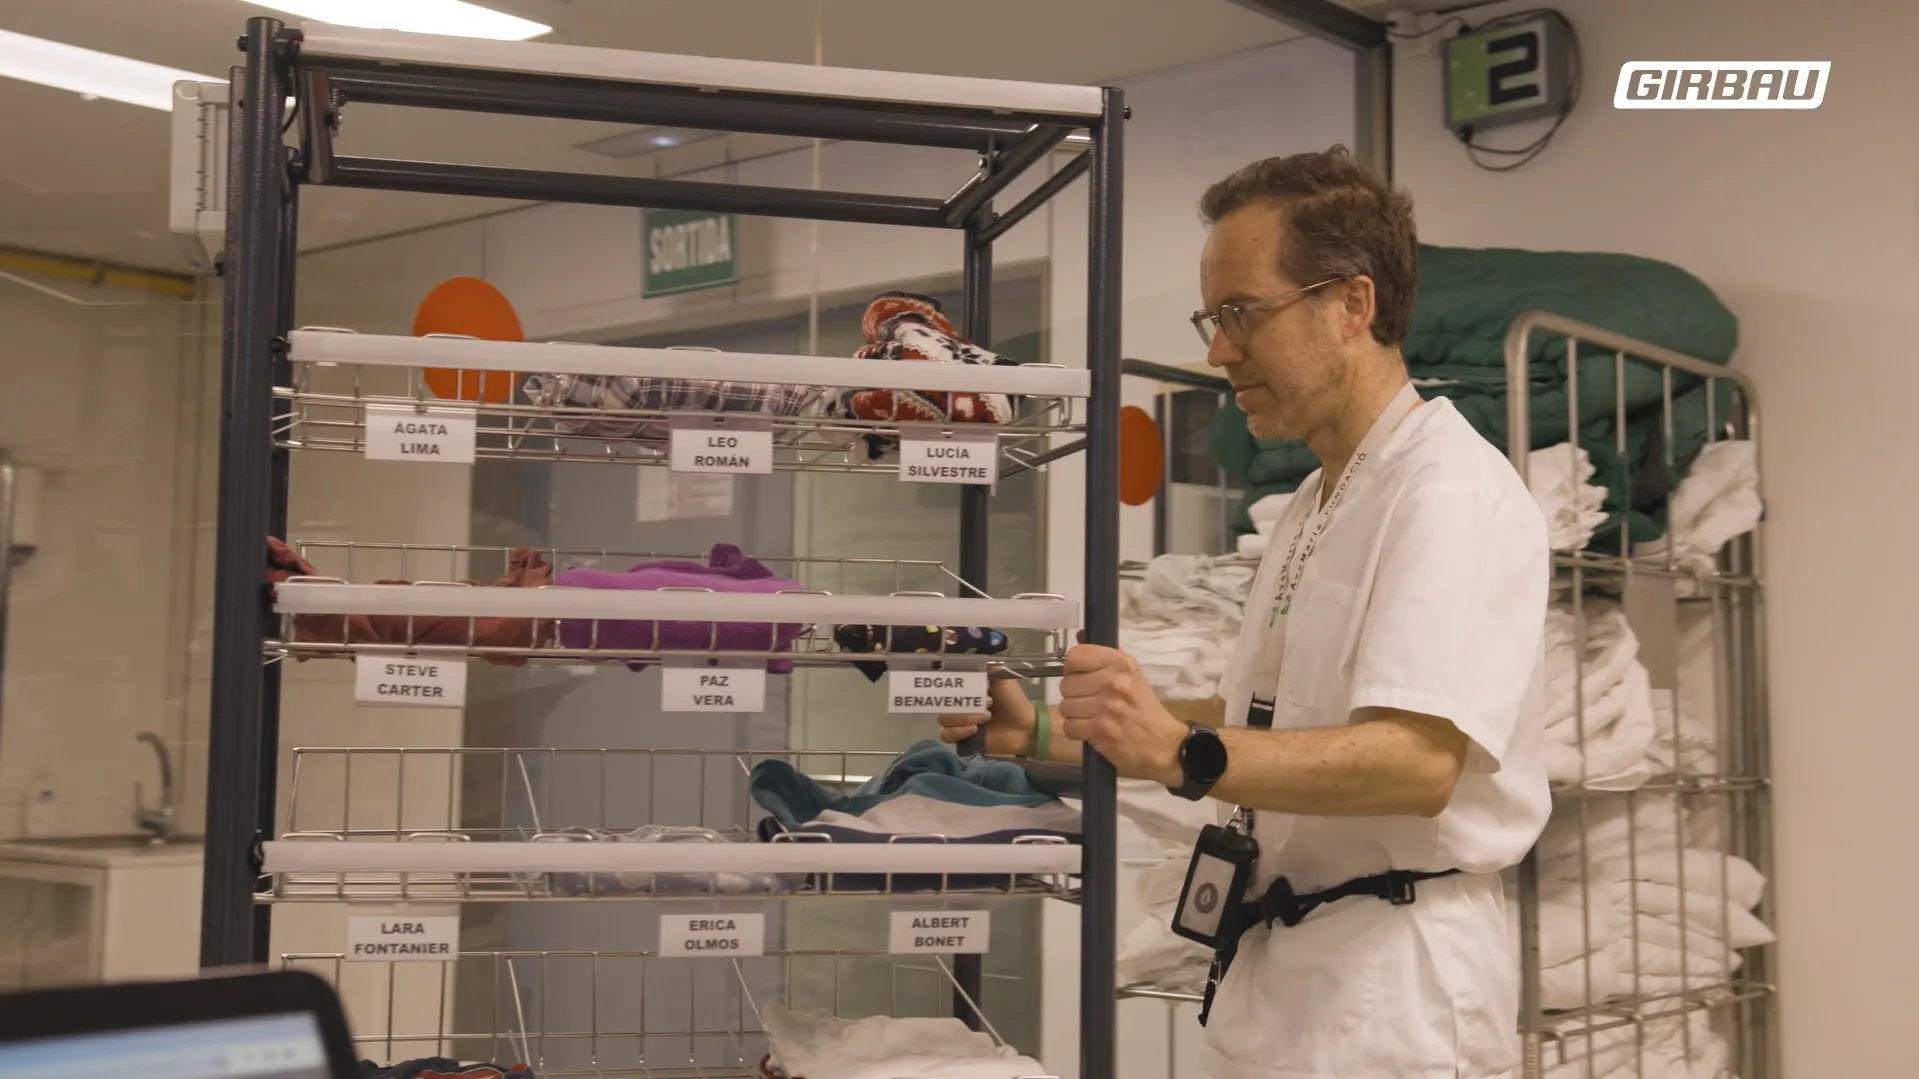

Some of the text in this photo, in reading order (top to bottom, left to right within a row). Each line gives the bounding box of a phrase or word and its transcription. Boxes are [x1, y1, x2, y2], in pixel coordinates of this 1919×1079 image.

[1486, 31, 1540, 106] 2
[650, 216, 731, 274] SORTIDA
[394, 420, 448, 436] ÁGATA
[401, 442, 440, 456] LIMA
[708, 436, 737, 449] LEO
[927, 445, 970, 460] LUCÍA
[694, 453, 749, 468] ROMÁN
[908, 464, 987, 479] SILVESTRE
[385, 663, 438, 678] STEVE
[700, 675, 728, 687] PAZ
[914, 676, 963, 689] EDGAR
[377, 683, 443, 699] CARTER
[693, 694, 734, 706] VERA
[894, 695, 982, 708] BENAVENTE
[381, 922, 425, 935] LARA
[689, 919, 736, 932] ERICA
[912, 916, 969, 929] ALBERT
[684, 938, 739, 951] OLMOS
[915, 935, 965, 948] BONET
[355, 942, 449, 955] FONTANIER
